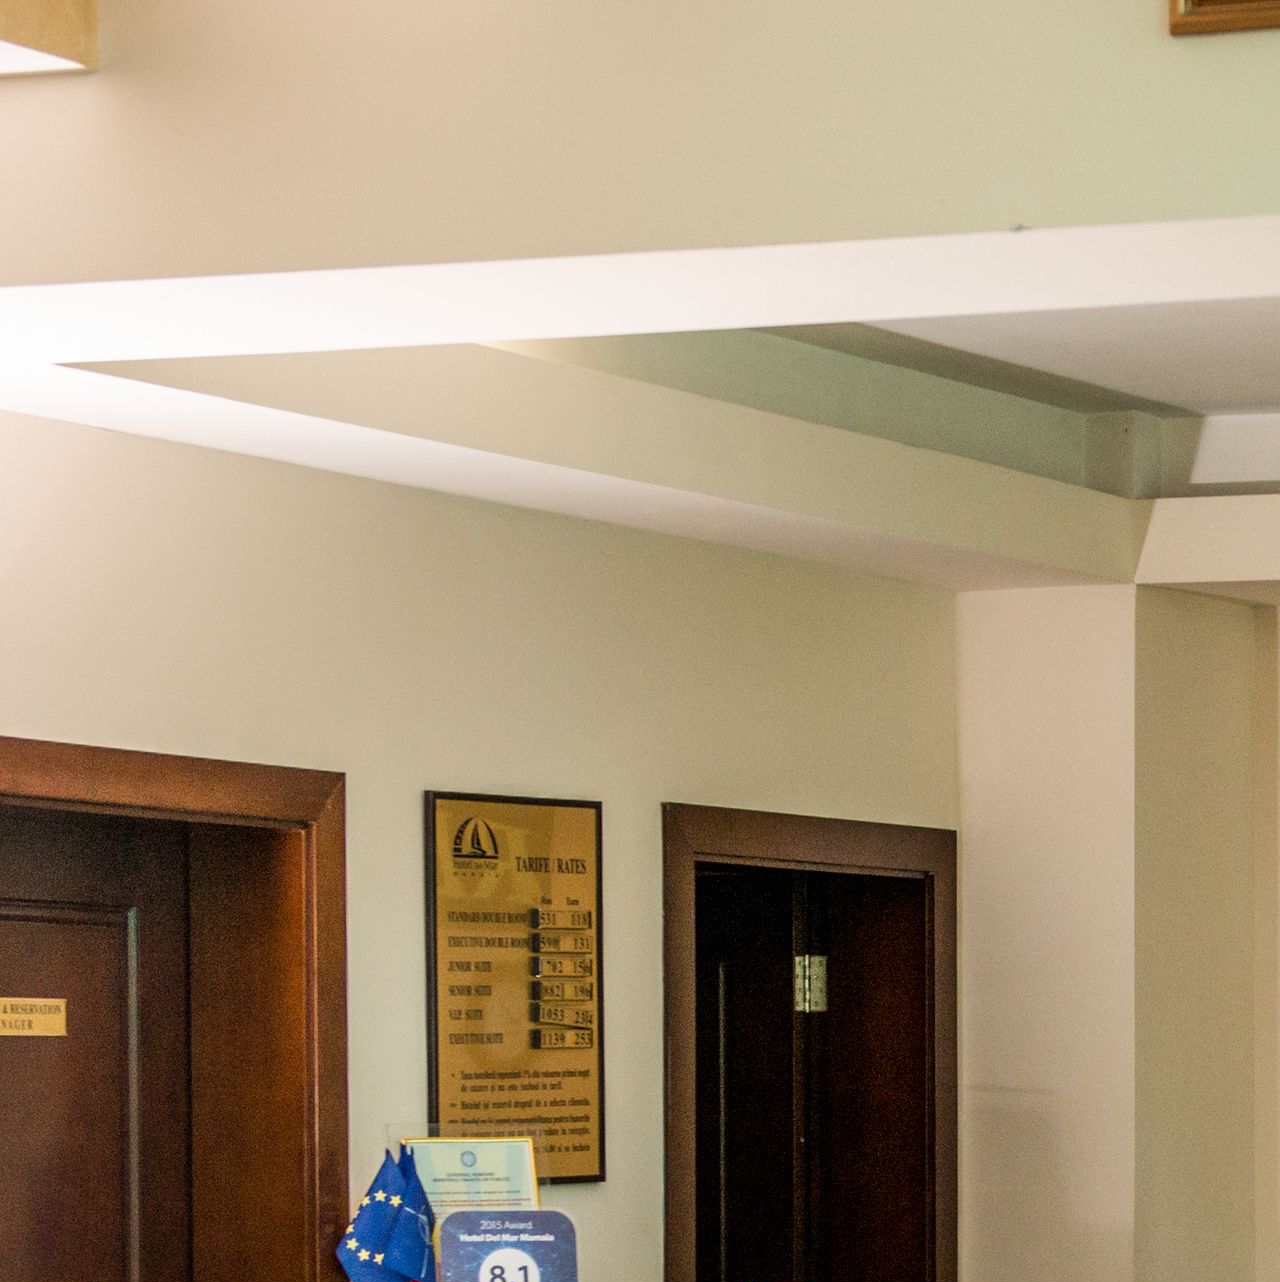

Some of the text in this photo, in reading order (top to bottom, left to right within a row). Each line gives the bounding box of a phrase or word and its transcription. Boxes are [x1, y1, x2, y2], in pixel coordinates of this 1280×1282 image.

[515, 856, 550, 873] TARIFE
[557, 858, 587, 874] RATES
[540, 912, 556, 924] 531
[541, 1009, 565, 1021] 1053
[504, 1221, 534, 1230] Award
[460, 1233, 485, 1242] Hotel
[485, 1233, 500, 1242] Del
[501, 1234, 519, 1242] Mar
